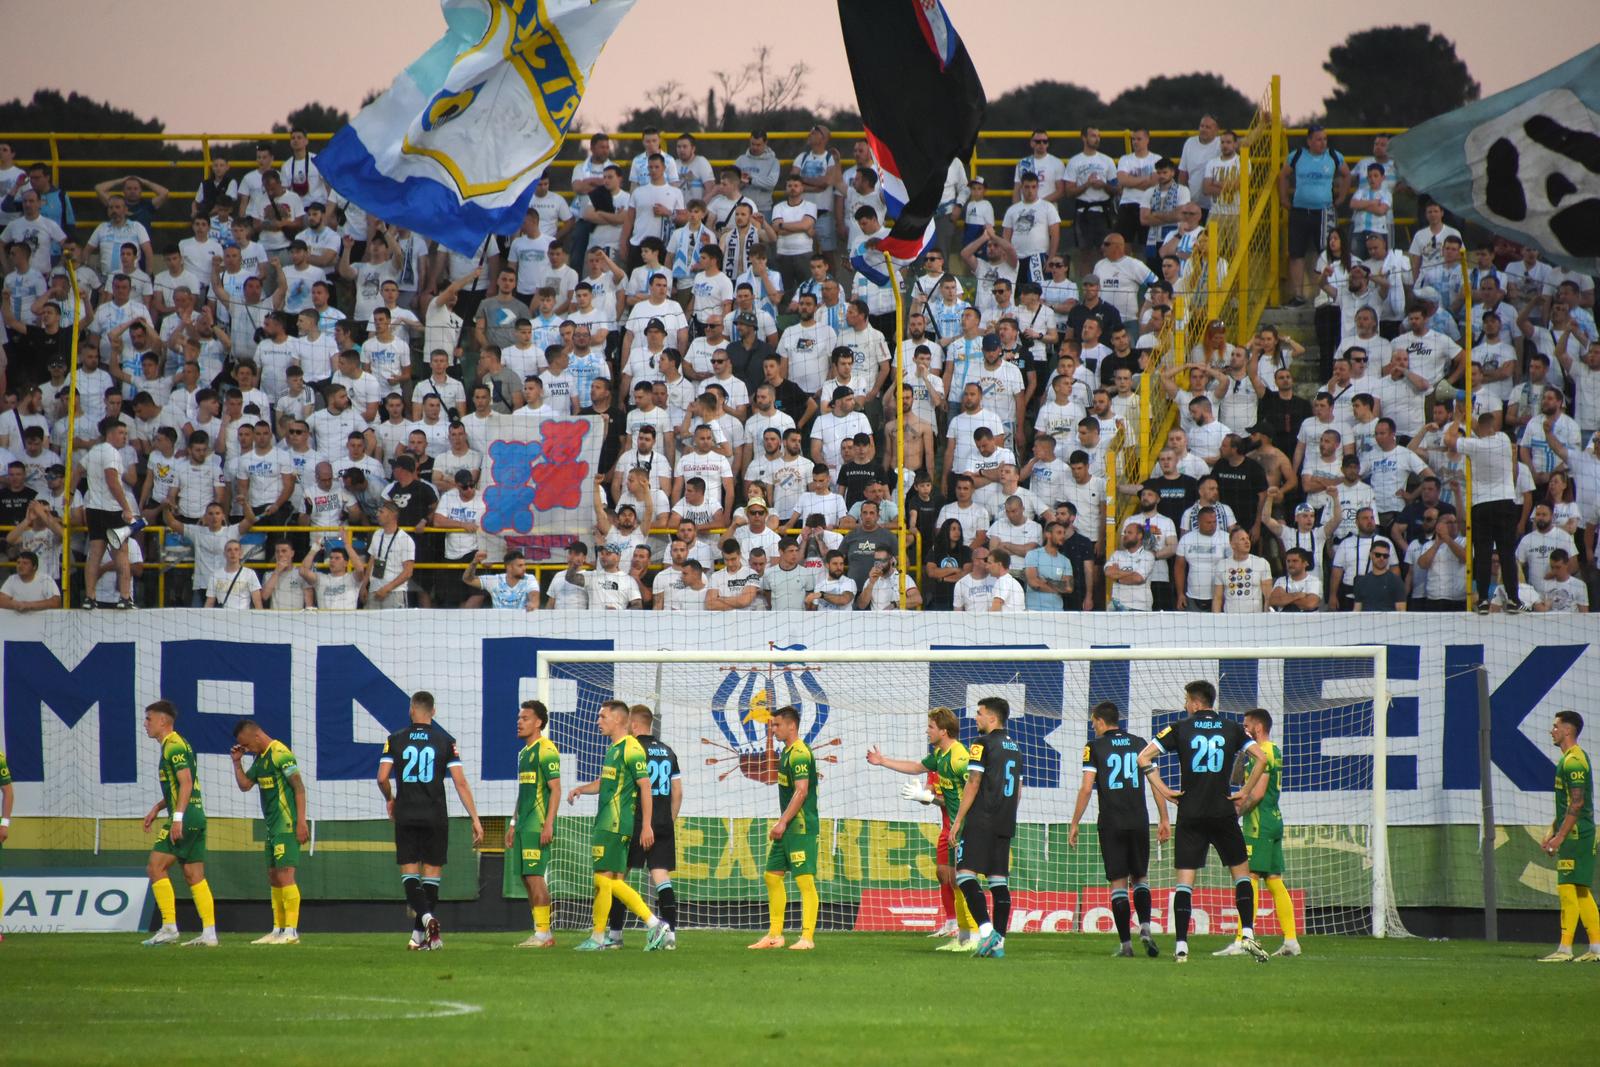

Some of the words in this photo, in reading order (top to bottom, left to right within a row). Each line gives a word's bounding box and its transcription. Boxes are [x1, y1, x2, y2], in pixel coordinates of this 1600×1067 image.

[171, 753, 186, 765] OK
[402, 745, 436, 783] 20
[794, 763, 809, 775] OK
[1106, 752, 1140, 790] 24
[1190, 734, 1226, 773] 26
[647, 759, 672, 796] 28
[1003, 760, 1016, 797] 5
[1569, 771, 1585, 780] OK
[3, 889, 130, 917] ATIO
